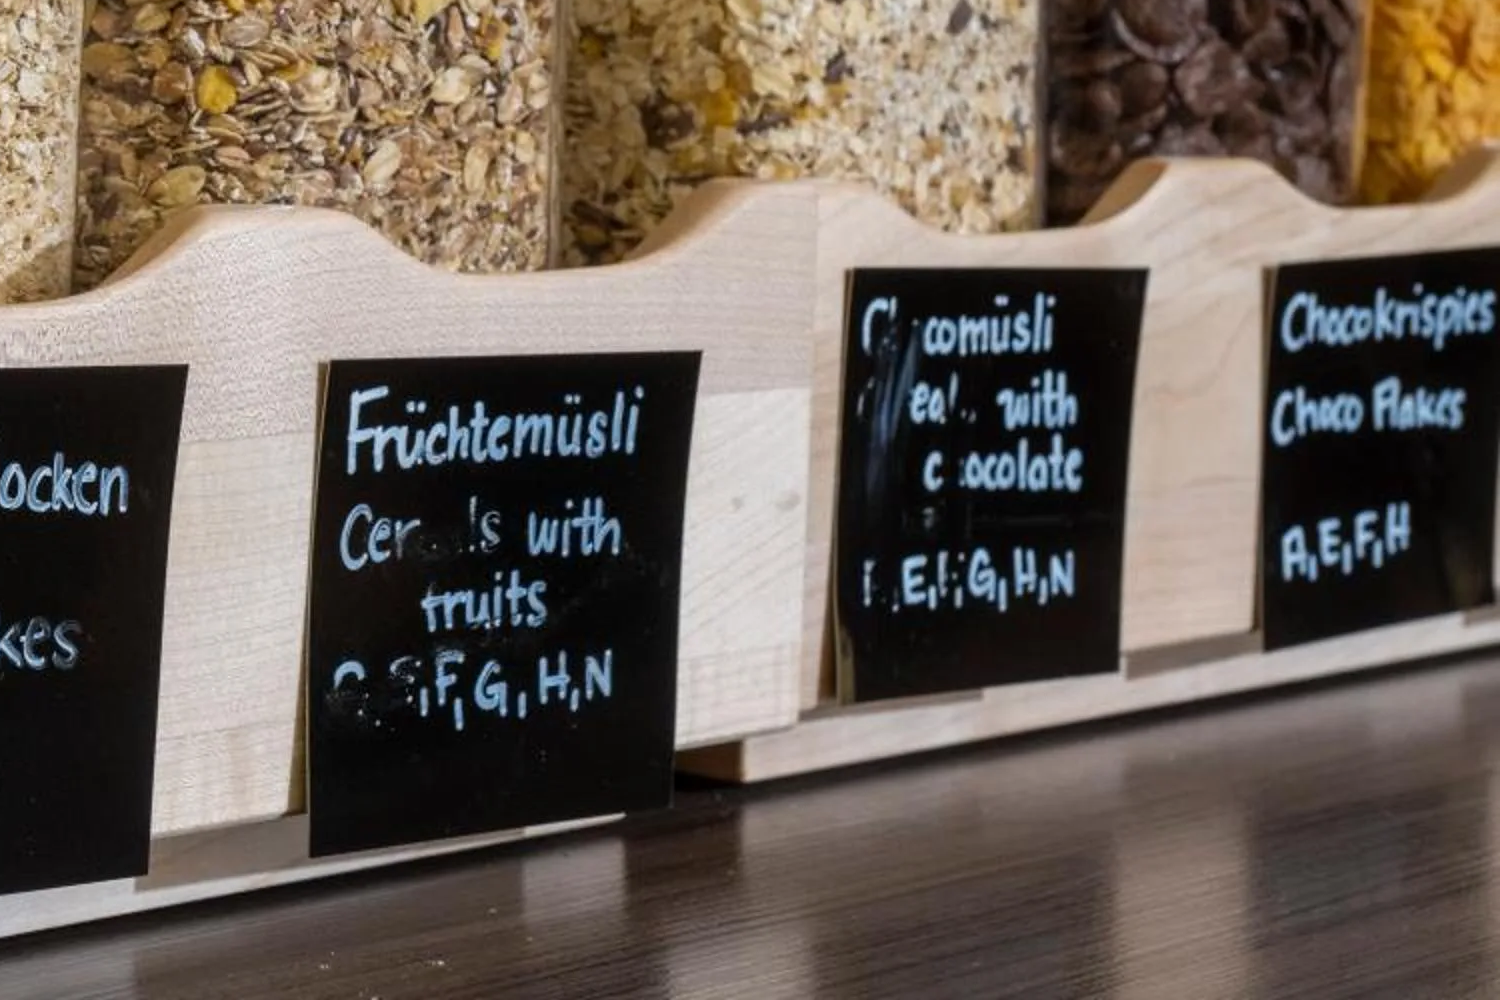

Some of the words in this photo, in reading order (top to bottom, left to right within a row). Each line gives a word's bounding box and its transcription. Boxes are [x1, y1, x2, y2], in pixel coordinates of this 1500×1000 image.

[1280, 283, 1497, 353] Chocokrispies
[346, 384, 645, 476] Früchtemüsli
[995, 368, 1079, 431] with
[1270, 386, 1365, 447] Choco
[922, 432, 1084, 492] cocolate
[338, 495, 501, 572] Cerls
[527, 496, 622, 558] with
[1280, 502, 1411, 582] A,E,F,H
